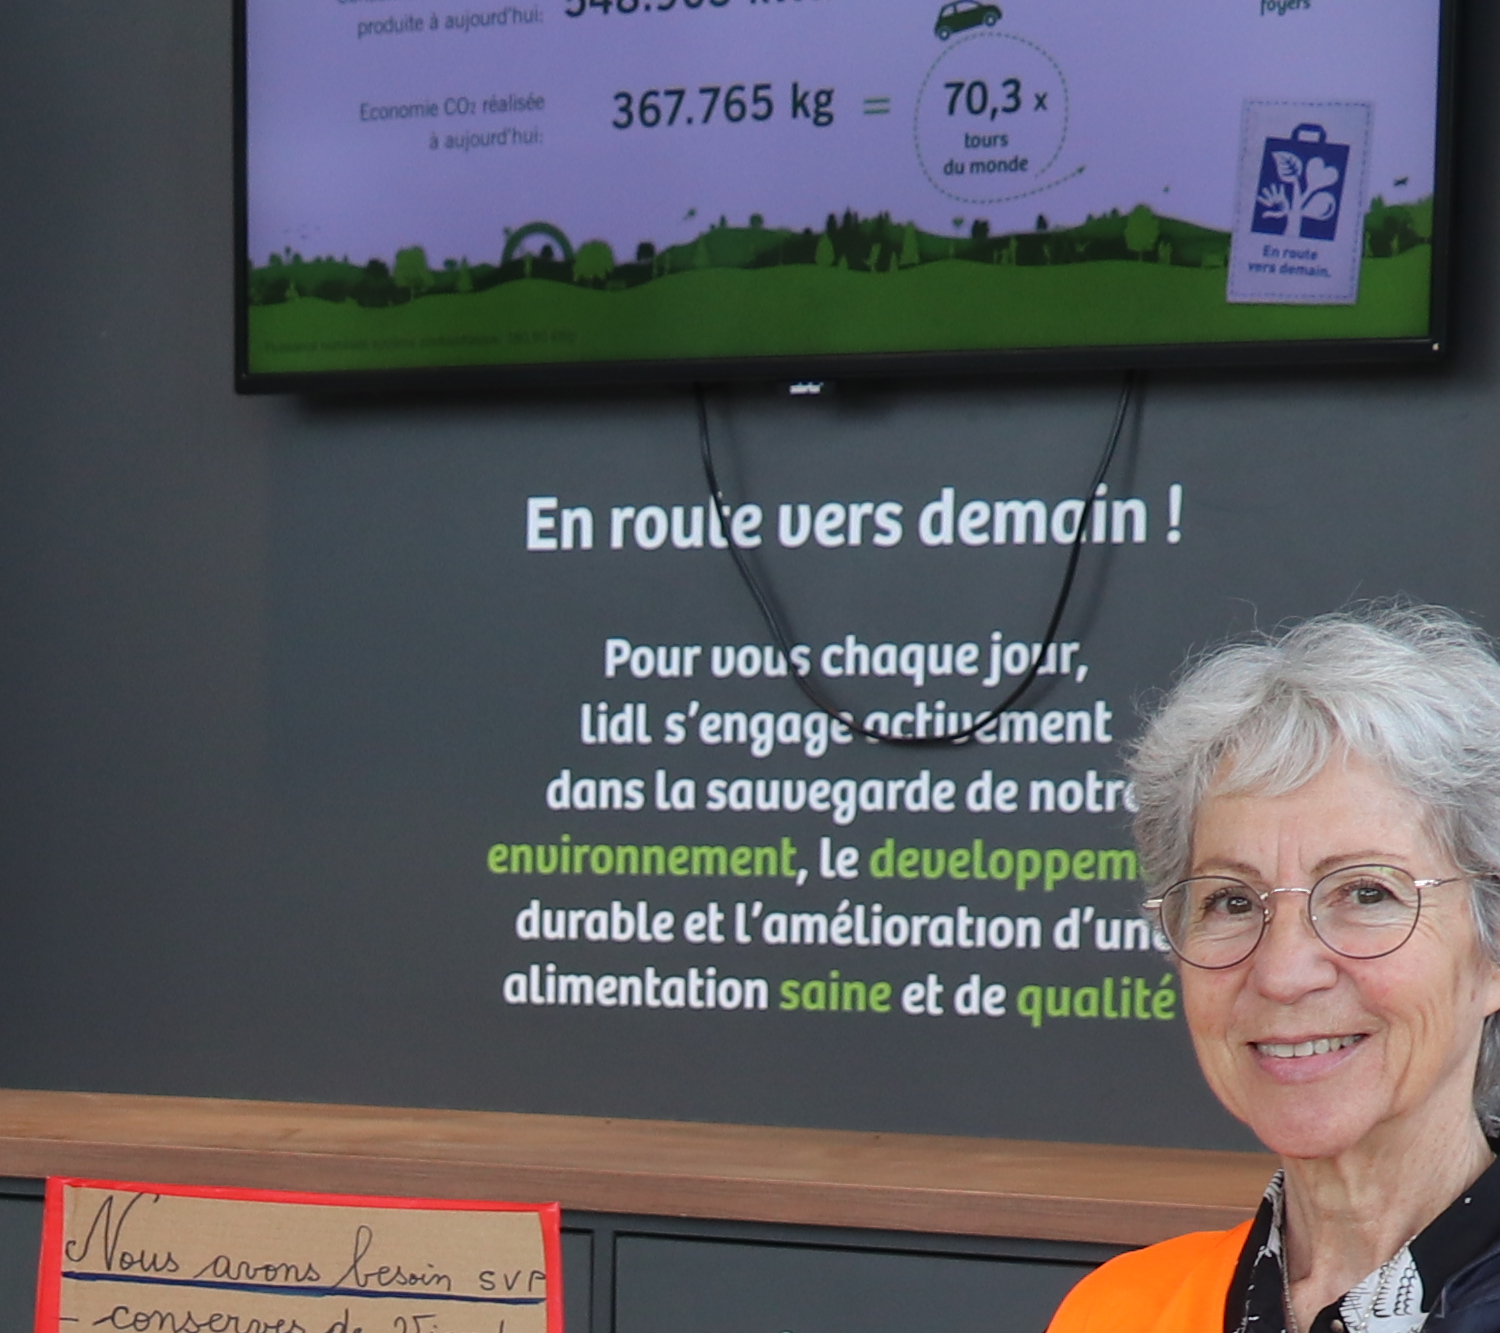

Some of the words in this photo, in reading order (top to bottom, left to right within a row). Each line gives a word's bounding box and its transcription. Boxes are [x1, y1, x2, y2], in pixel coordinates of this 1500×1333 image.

[357, 15, 424, 38] produite
[444, 8, 544, 33] aujourd'hui:
[359, 99, 438, 122] Economie
[483, 91, 545, 114] réalisée
[612, 83, 773, 129] 367.765
[791, 81, 834, 127] kg
[944, 79, 1022, 121] 70,3
[1034, 91, 1047, 111] x
[429, 130, 440, 150] à
[444, 126, 544, 151] aujourd'hui:
[964, 131, 1008, 150] tours
[943, 157, 969, 176] du
[972, 154, 1029, 175] monde
[1247, 260, 1276, 275] vers
[1279, 261, 1331, 279] demain.
[1262, 245, 1280, 261] En
[1283, 247, 1319, 262] route
[526, 497, 593, 551] En
[610, 494, 761, 551] route
[778, 504, 903, 548] vers
[920, 488, 1147, 545] demain
[606, 639, 702, 679] Pour
[712, 643, 810, 678] vous
[820, 636, 979, 686] chaque
[982, 632, 1089, 686] jour,
[581, 702, 651, 745] lidl
[665, 701, 853, 757] s'engage
[863, 700, 1113, 746] activement
[546, 771, 645, 811] dans
[655, 771, 696, 811] la
[706, 769, 958, 826] sauvegarde
[966, 770, 1018, 812] de
[487, 834, 808, 886] environnement,
[820, 838, 858, 880] le
[516, 900, 674, 943] durable
[684, 908, 723, 946] et
[735, 899, 1041, 949] l'amélioration
[504, 966, 768, 1010] alimentation
[780, 972, 891, 1013] saine
[902, 978, 942, 1015] et
[954, 974, 1006, 1017] de
[1017, 973, 1177, 1026] qualité
[65, 1192, 180, 1272] Nous
[193, 1255, 321, 1283] avons
[332, 1225, 453, 1292] besoin
[479, 1269, 546, 1292] SVP
